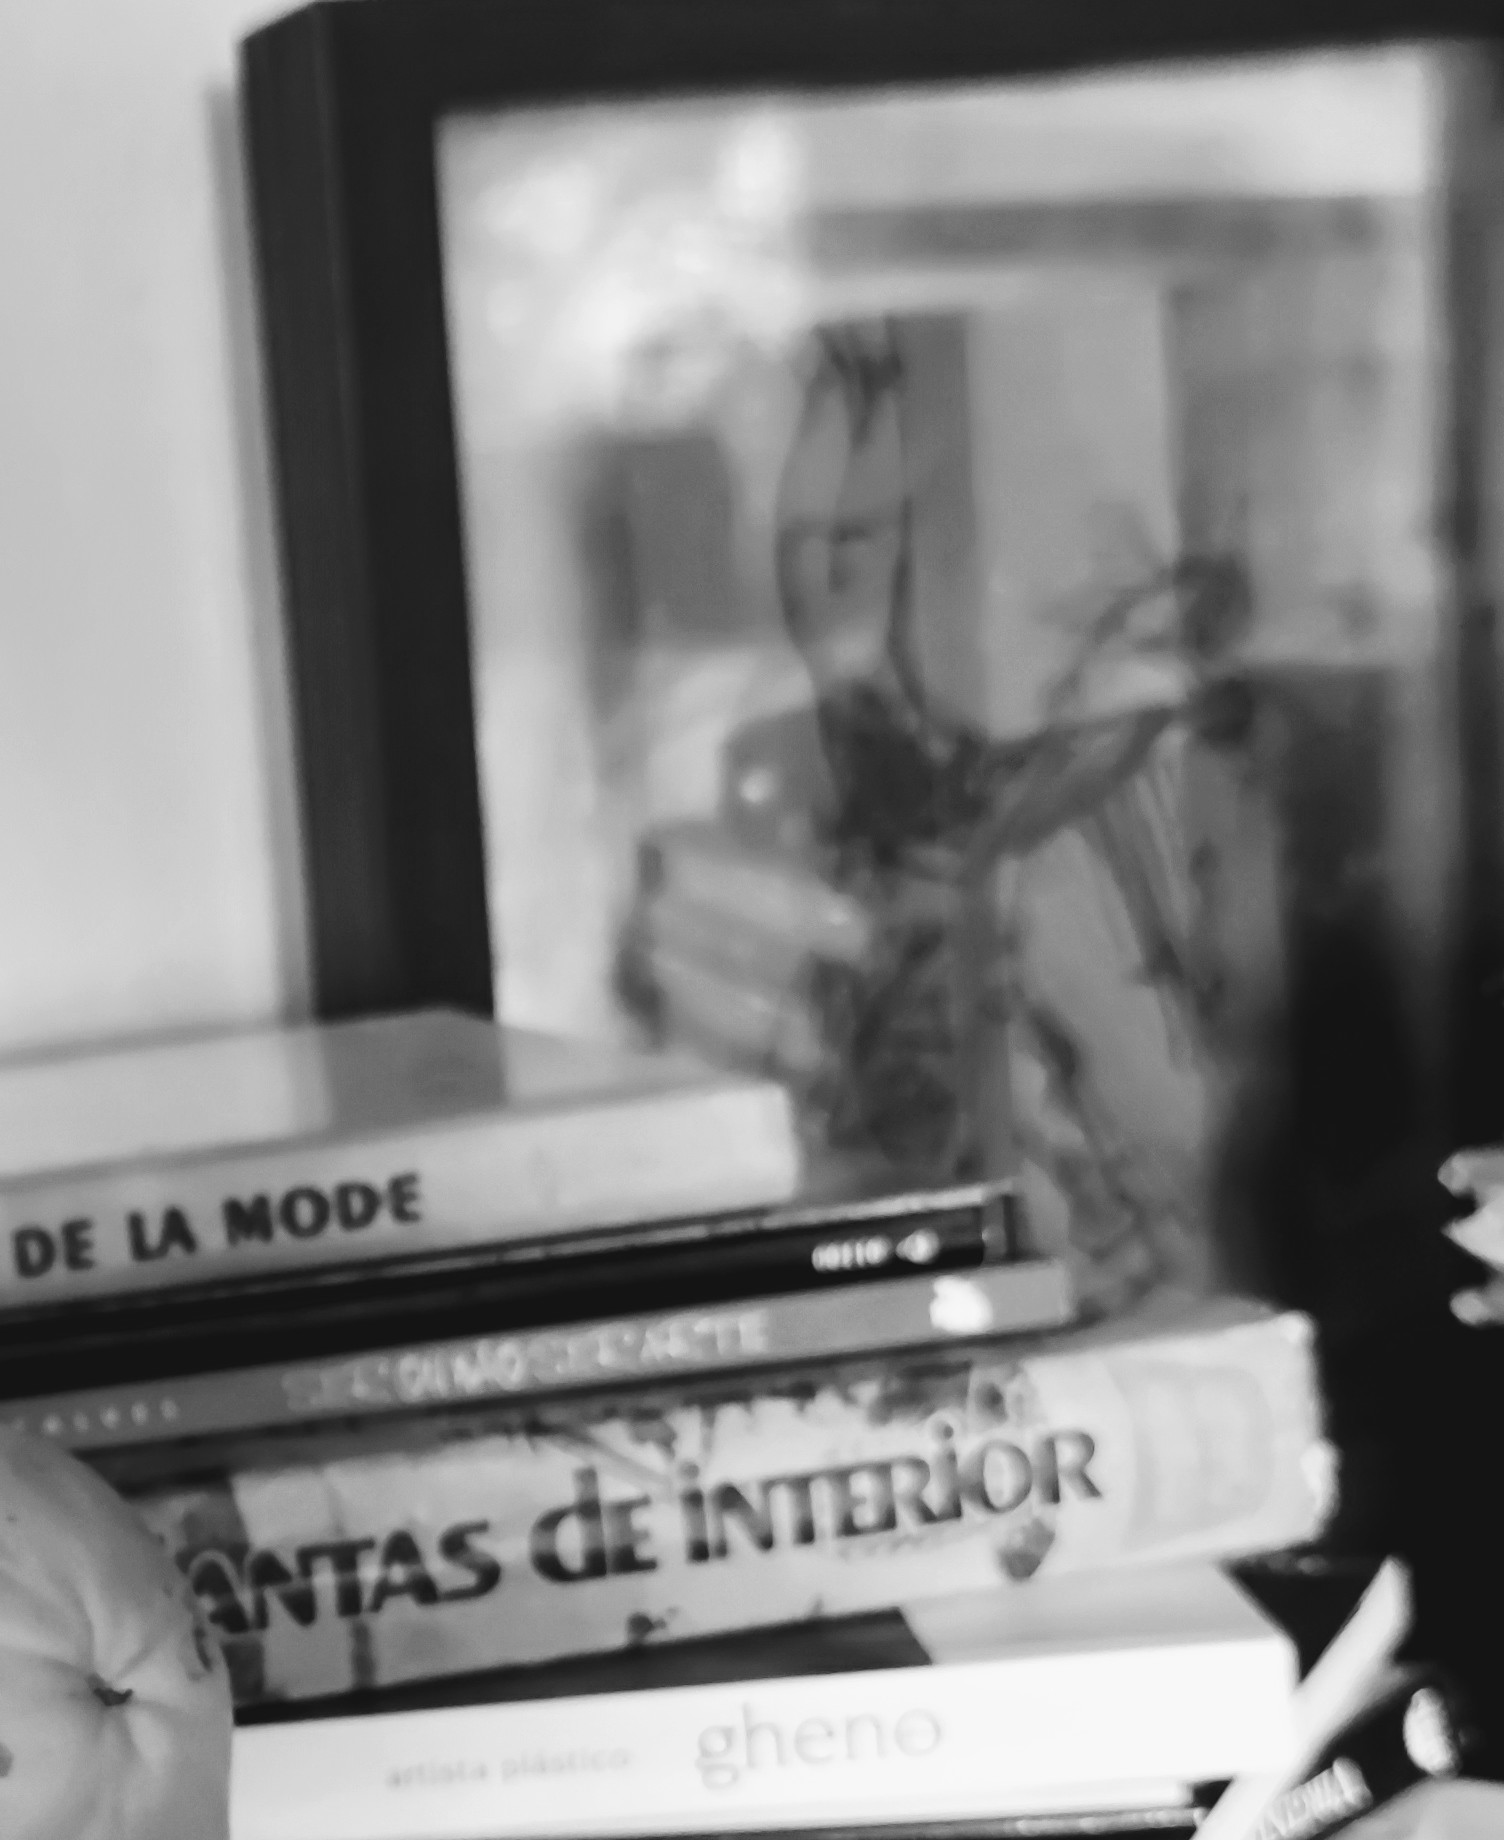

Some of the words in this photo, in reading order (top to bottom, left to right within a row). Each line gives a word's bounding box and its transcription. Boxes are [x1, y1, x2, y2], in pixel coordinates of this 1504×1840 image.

[13, 1217, 97, 1280] DE
[127, 1205, 197, 1264] LA
[222, 1172, 425, 1249] MODE
[694, 1701, 942, 1790] gheno
